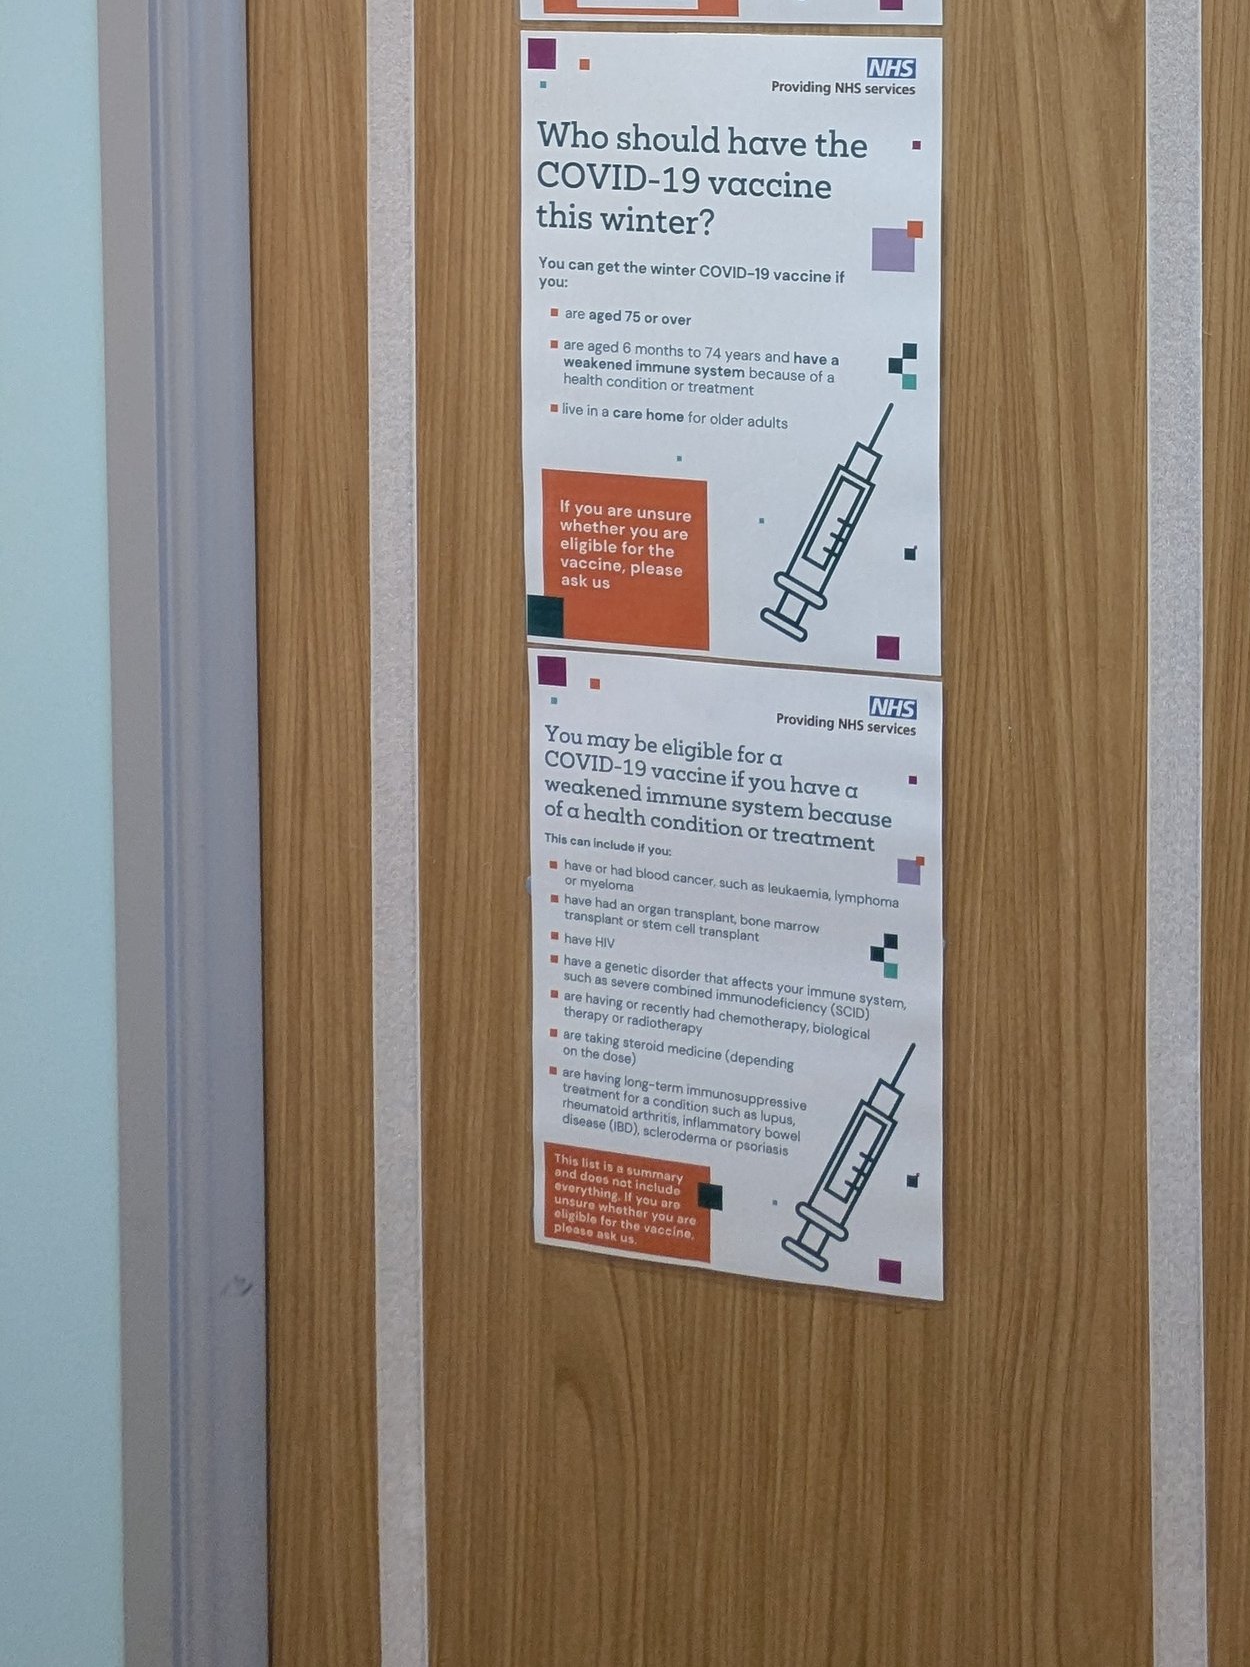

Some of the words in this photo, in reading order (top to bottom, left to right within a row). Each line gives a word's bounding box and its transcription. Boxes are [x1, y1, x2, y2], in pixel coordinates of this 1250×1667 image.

[868, 58, 915, 78] NHS
[772, 80, 831, 96] Providing
[835, 82, 861, 94] NHS
[865, 83, 915, 95] services
[537, 120, 608, 149] Who
[616, 122, 720, 153] should
[727, 126, 806, 156] have
[814, 129, 867, 158] the
[537, 160, 700, 193] COVID-19
[707, 171, 831, 199] vaccine
[535, 200, 592, 229] this
[599, 205, 714, 235] winter?
[538, 256, 564, 269] You
[568, 261, 593, 271] can
[597, 261, 620, 275] get
[623, 260, 647, 274] the
[650, 262, 696, 276] winter
[699, 264, 769, 280] COVID-19
[773, 269, 831, 283] vaccine
[835, 270, 845, 283] if
[538, 277, 568, 290] you:
[565, 309, 585, 319] are
[588, 309, 621, 324] aged
[624, 310, 641, 322] 75
[644, 314, 658, 323] or
[661, 315, 691, 325] over
[563, 341, 584, 351] are
[587, 340, 619, 355] aged
[622, 341, 631, 353] 6
[635, 344, 683, 357] months
[687, 347, 701, 358] to
[704, 346, 721, 359] 74
[724, 350, 761, 363] years
[764, 350, 789, 363] and
[793, 351, 827, 365] have
[830, 356, 839, 366] a
[563, 356, 632, 371] weakened
[635, 359, 690, 374] immune
[694, 366, 744, 379] system
[749, 366, 805, 381] because
[809, 370, 822, 382] of
[826, 374, 834, 383] a
[563, 372, 602, 386] health
[606, 376, 667, 390] condition
[670, 382, 684, 391] or
[687, 381, 754, 396] treatment
[562, 402, 583, 415] live
[586, 404, 598, 416] in
[601, 408, 609, 417] a
[612, 409, 642, 419] care
[646, 408, 684, 422] home
[687, 410, 706, 424] for
[709, 413, 744, 426] older
[747, 415, 788, 429] adults
[871, 698, 916, 718] NHS
[776, 712, 834, 731] Providing
[838, 717, 863, 731] NHS
[867, 722, 916, 736] services
[544, 724, 583, 745] You
[587, 734, 630, 754] may
[634, 733, 657, 753] be
[662, 737, 732, 762] eligible
[737, 744, 765, 764] for
[769, 753, 782, 766] a
[544, 751, 646, 777] COVID-19
[651, 765, 727, 786] vaccine
[731, 769, 745, 787] if
[748, 776, 785, 793] you
[790, 774, 840, 797] have
[845, 786, 858, 798] a
[544, 778, 642, 801] weakened
[646, 786, 727, 811] immune
[731, 800, 803, 819] system
[808, 802, 892, 828] because
[544, 799, 564, 817] of
[567, 806, 579, 819] a
[583, 802, 646, 826] health
[650, 814, 743, 837] condition
[747, 826, 768, 840] or
[772, 826, 875, 852] treatment
[563, 953, 591, 968] have
[594, 960, 601, 969] a
[604, 961, 648, 975] genetic
[651, 965, 701, 981] disorder
[704, 971, 728, 985] that
[731, 975, 773, 991] affects
[776, 983, 804, 995] your
[807, 983, 856, 1003] immune
[859, 994, 908, 1011] system,
[563, 971, 591, 983] such
[594, 975, 607, 985] as
[611, 978, 649, 991] severe
[653, 983, 712, 999] combined
[716, 988, 827, 1016] immunodeficiency
[830, 1002, 869, 1021] (SCID)
